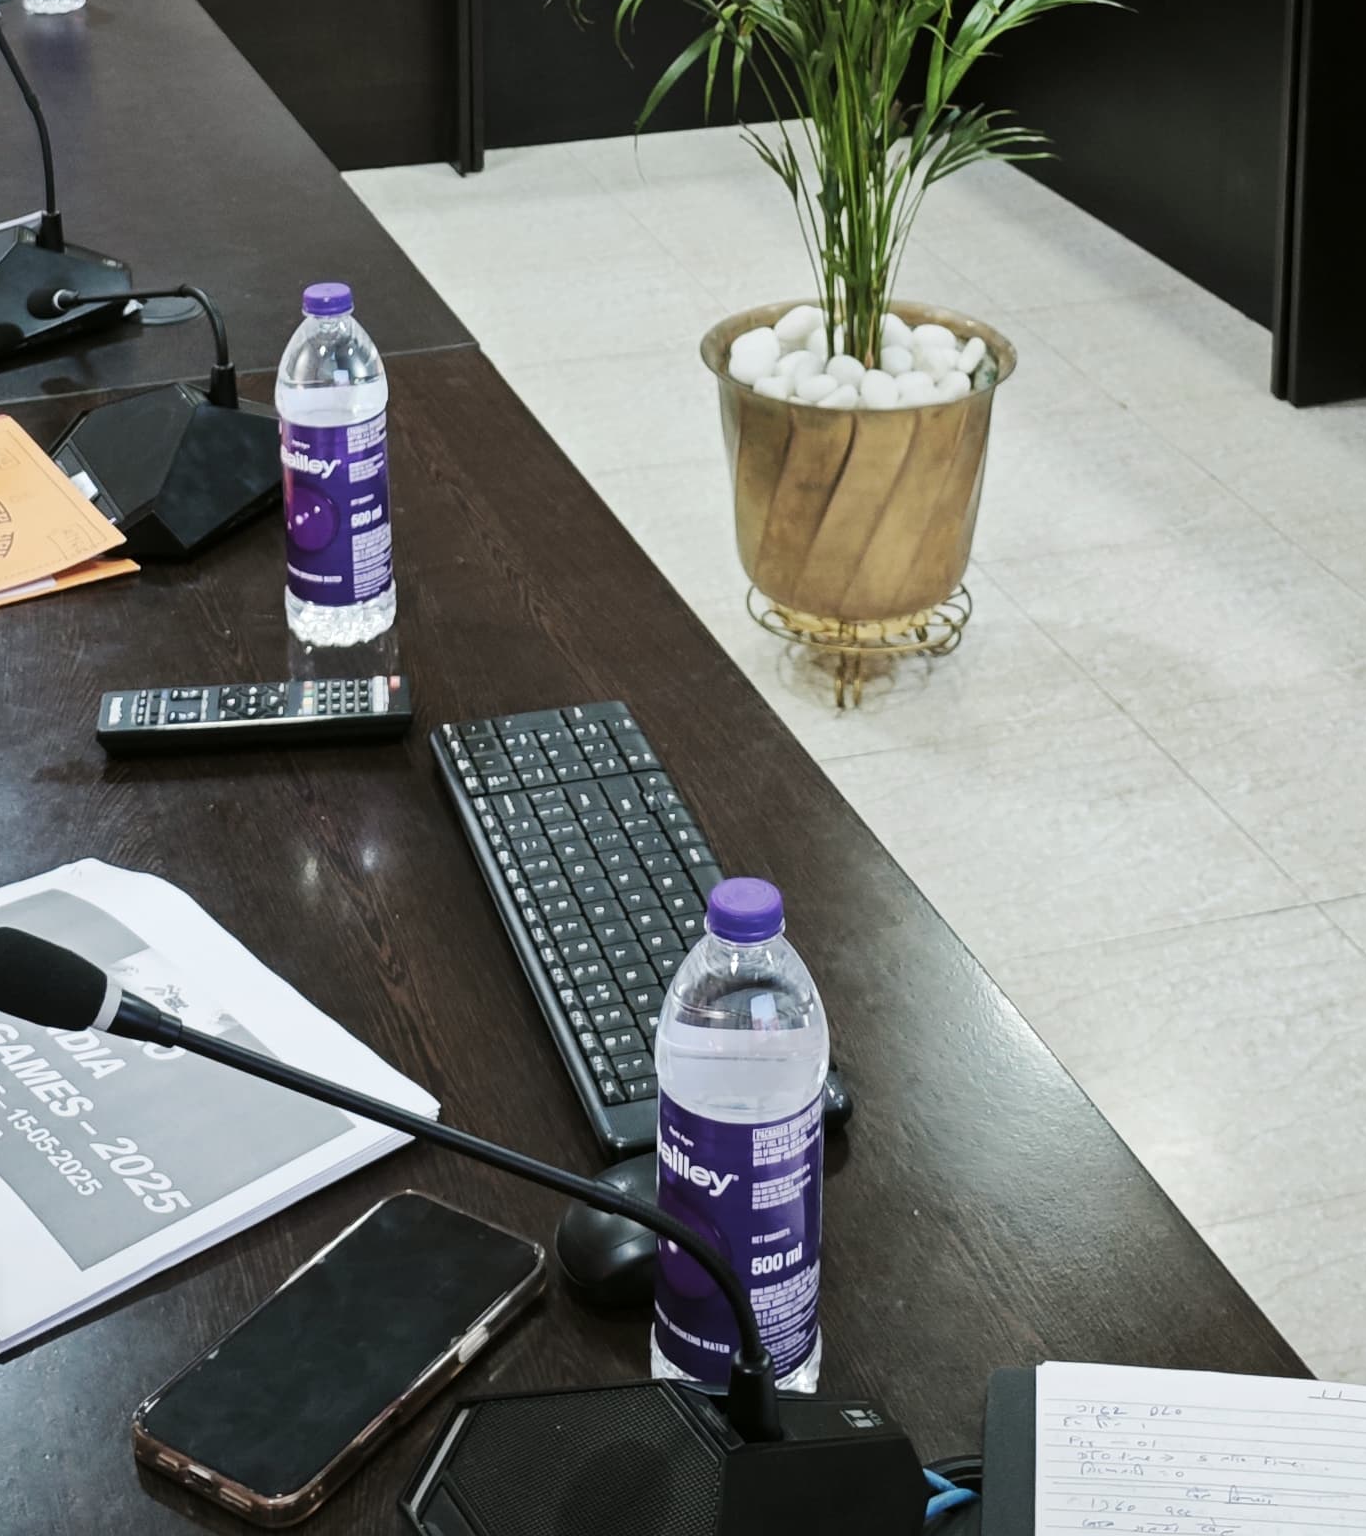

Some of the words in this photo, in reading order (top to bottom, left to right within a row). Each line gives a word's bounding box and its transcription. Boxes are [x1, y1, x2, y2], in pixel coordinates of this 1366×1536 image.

[7, 1108, 103, 1196] 15-05-2025
[89, 1136, 192, 1214] 2025
[751, 1252, 783, 1276] 500
[785, 1242, 803, 1267] ml
[702, 1340, 731, 1354] WATER
